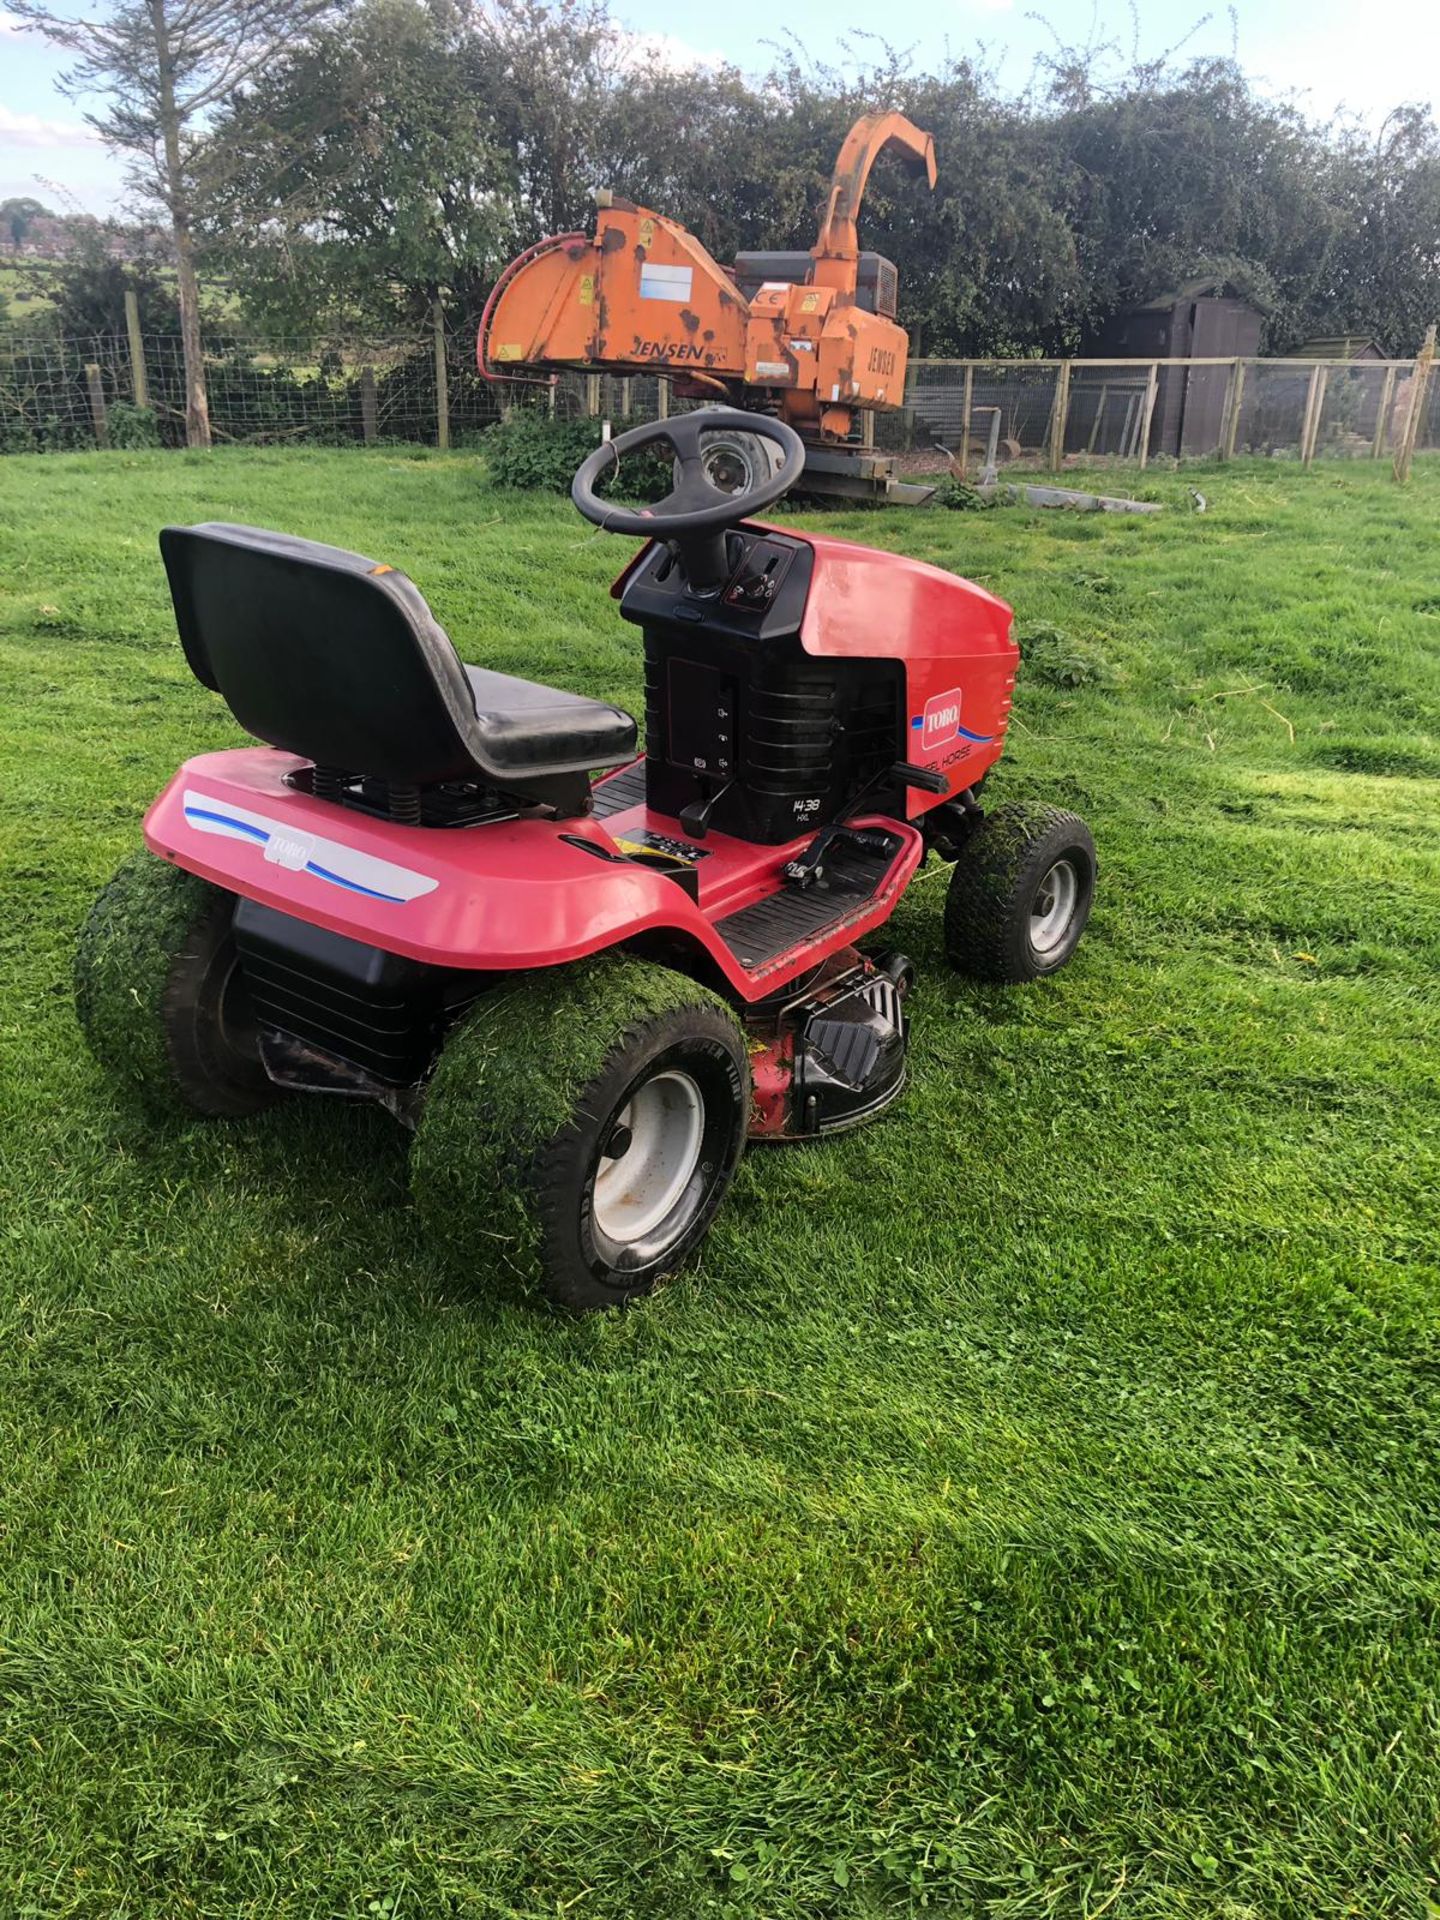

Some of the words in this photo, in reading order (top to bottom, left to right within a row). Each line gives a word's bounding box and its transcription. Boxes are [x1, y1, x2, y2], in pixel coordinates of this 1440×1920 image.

[630, 337, 704, 360] JENSEN
[868, 347, 896, 377] JENSEN
[928, 705, 959, 733] TORO
[942, 744, 972, 767] HORSE
[273, 837, 306, 860] TORO
